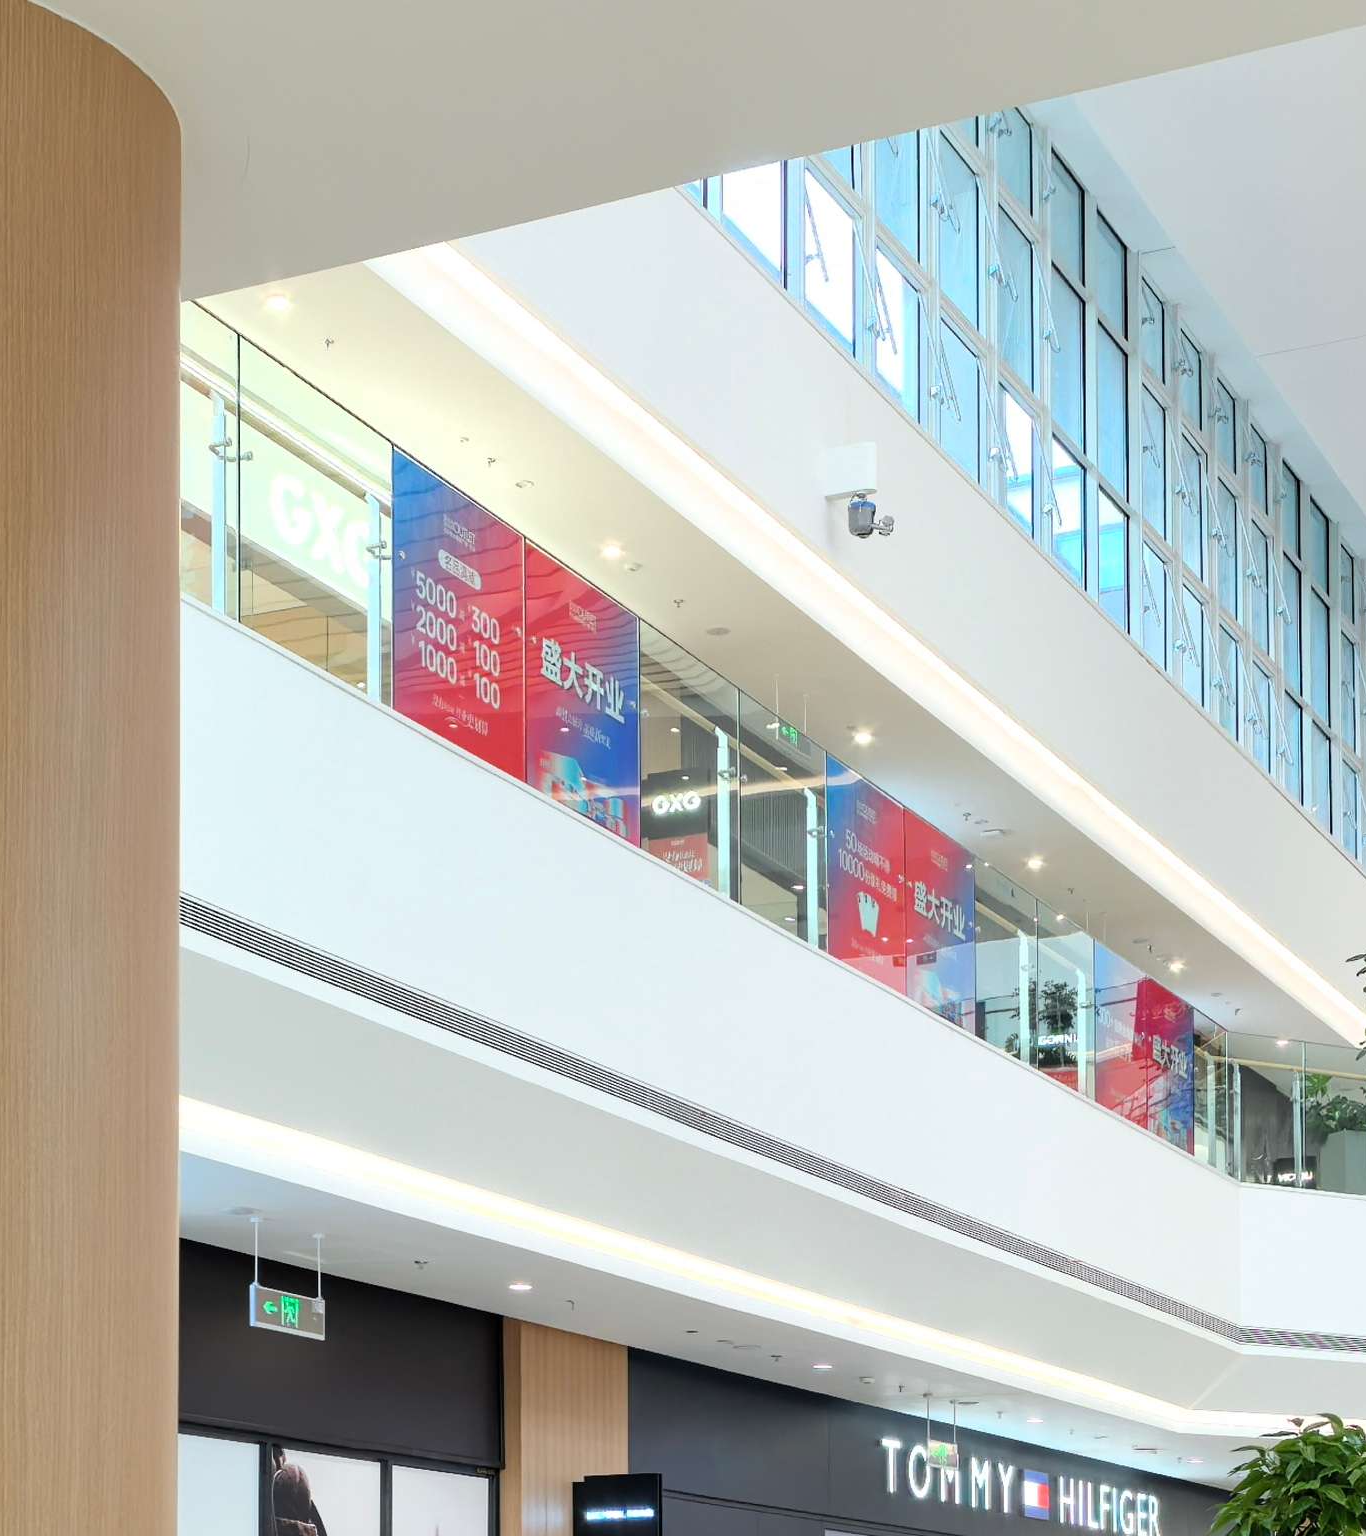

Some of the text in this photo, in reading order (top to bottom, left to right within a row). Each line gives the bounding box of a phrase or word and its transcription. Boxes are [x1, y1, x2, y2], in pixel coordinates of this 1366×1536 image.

[416, 573, 500, 645] 5000 300
[416, 606, 500, 677] 2000 100
[418, 640, 500, 710] 1000 100
[540, 637, 625, 724] 盛大开业
[914, 880, 966, 941] 盛大开业
[880, 1437, 1015, 1514] TOMMY
